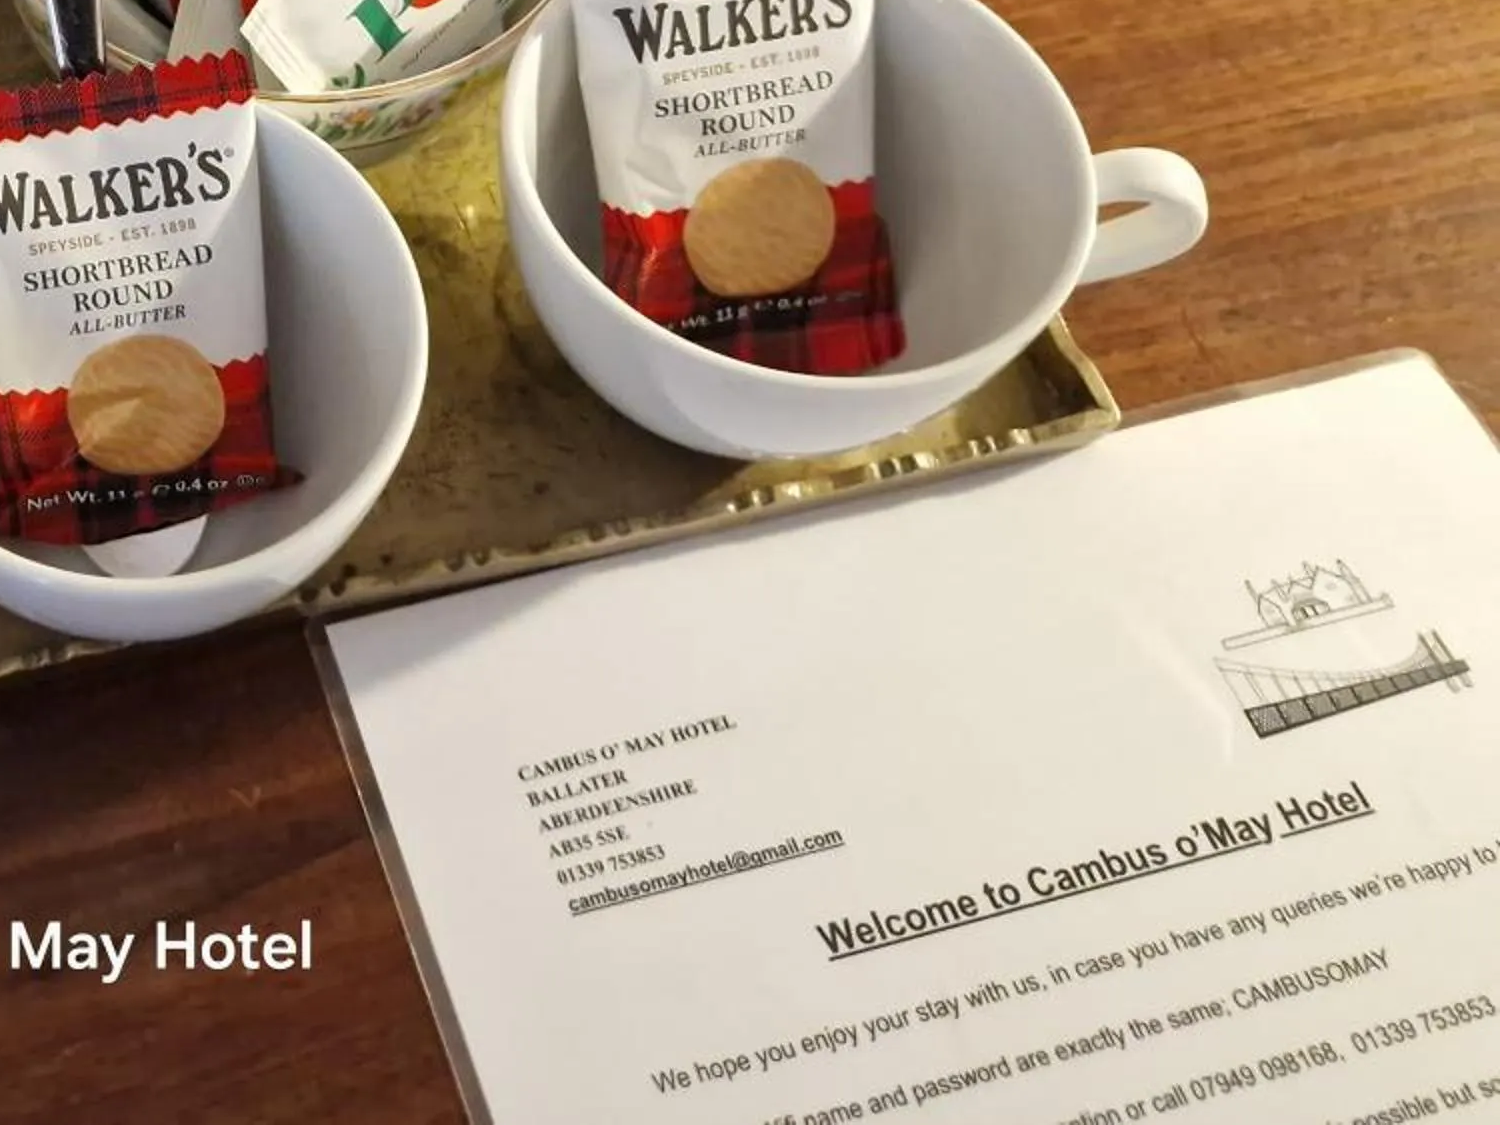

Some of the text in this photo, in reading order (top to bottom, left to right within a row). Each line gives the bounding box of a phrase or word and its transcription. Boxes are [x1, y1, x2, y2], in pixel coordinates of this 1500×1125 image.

[654, 70, 834, 118] SHORTBREAD
[662, 62, 734, 86] SPEYSIDE
[701, 104, 795, 137] ROUND
[693, 128, 807, 158] ALL-BUTTER
[28, 233, 104, 257] SPEYSIDE
[121, 226, 156, 243] EST.
[161, 217, 197, 235] 1898
[23, 243, 213, 292] SHORTBREAD
[73, 278, 173, 313] ROUND
[69, 304, 186, 336] ALL-BUTTER
[66, 489, 101, 504] Wt.
[107, 489, 126, 501] 11
[517, 748, 597, 781] CAMBUS
[624, 731, 666, 755] MAY
[669, 714, 738, 744] HOTEL
[526, 769, 628, 807] BALLATER
[538, 779, 699, 834] ABERDEENSHIRE
[549, 825, 630, 860] AB35 5SE
[556, 844, 666, 886] 01339 753853
[567, 828, 844, 915] cambusomayhotel@gmail.com
[816, 780, 1372, 955] Welcome to Cambus o'May Hotel
[650, 846, 1497, 1093] We hope you enjoy your stay with us, in case you have any queries we're happy to
[868, 1085, 908, 1115] and
[912, 1056, 1012, 1106] password
[1015, 1048, 1051, 1074] are
[1054, 1026, 1126, 1062] exactly
[1127, 1017, 1164, 1040] the
[1166, 998, 1232, 1030] same;
[1231, 947, 1390, 1010] CAMBUSOMAY
[1125, 1099, 1146, 1121] or
[1151, 1083, 1189, 1114] call
[1189, 1063, 1257, 1102] 07949
[1258, 1041, 1346, 1081] 098168,
[1350, 1018, 1417, 1055] 01339
[1416, 995, 1496, 1034] 753853
[1437, 1082, 1477, 1108] but
